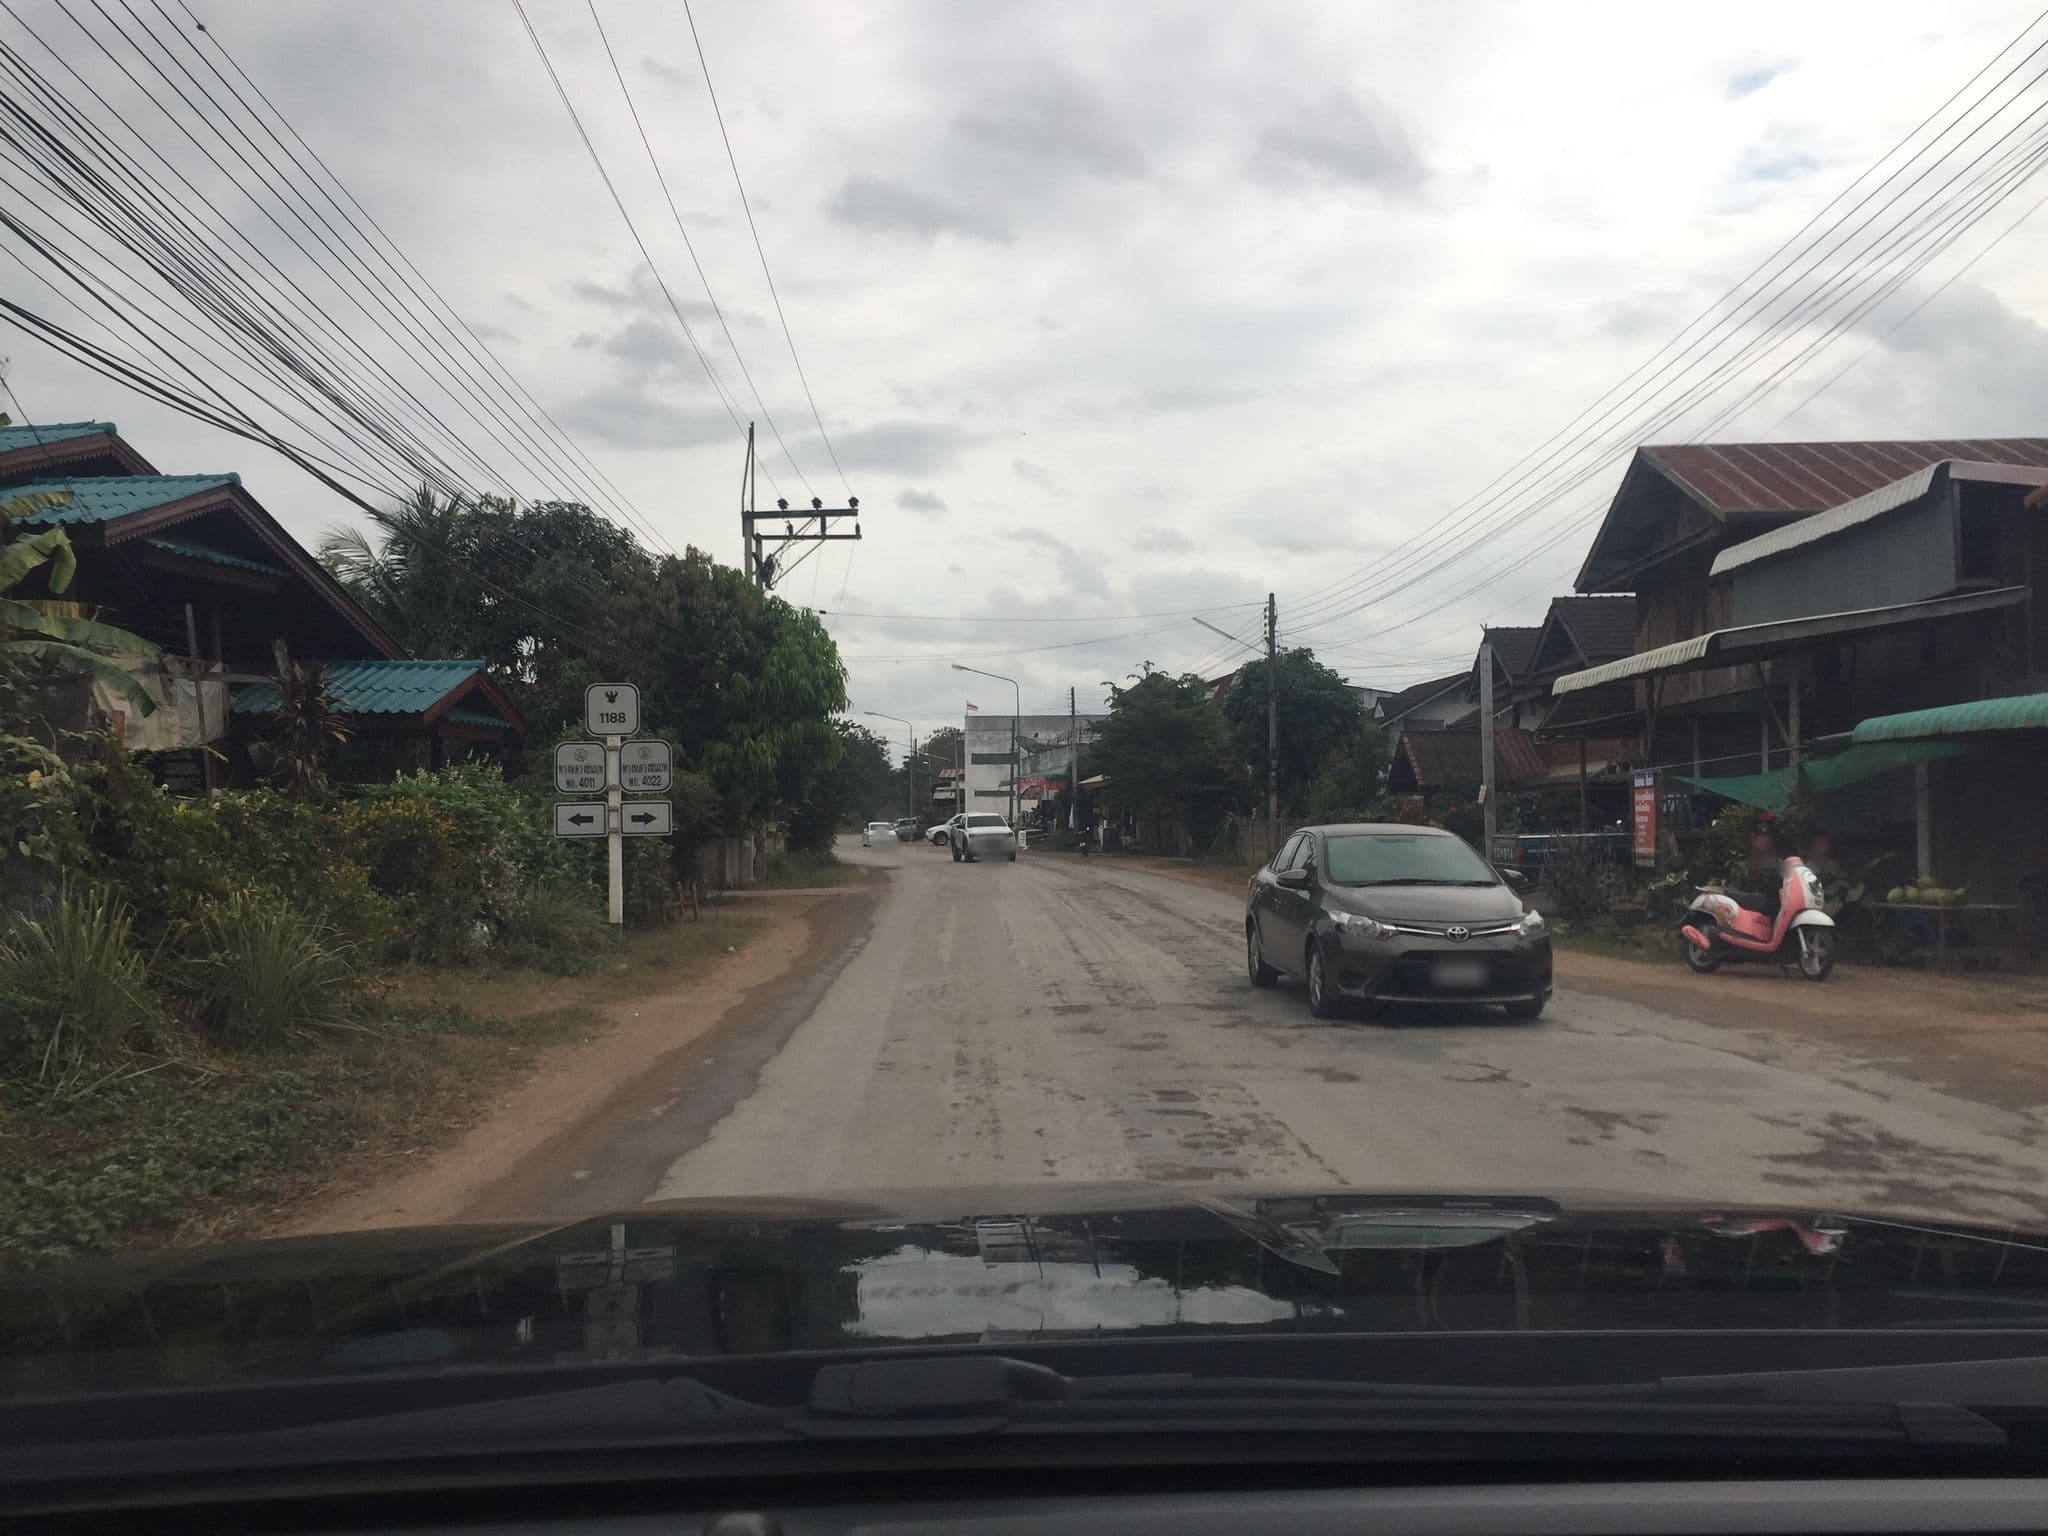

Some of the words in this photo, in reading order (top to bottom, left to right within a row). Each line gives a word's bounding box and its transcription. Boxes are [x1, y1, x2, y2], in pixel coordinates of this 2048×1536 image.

[599, 712, 626, 724] 1188
[579, 777, 596, 788] 4011
[642, 775, 662, 787] 4022
